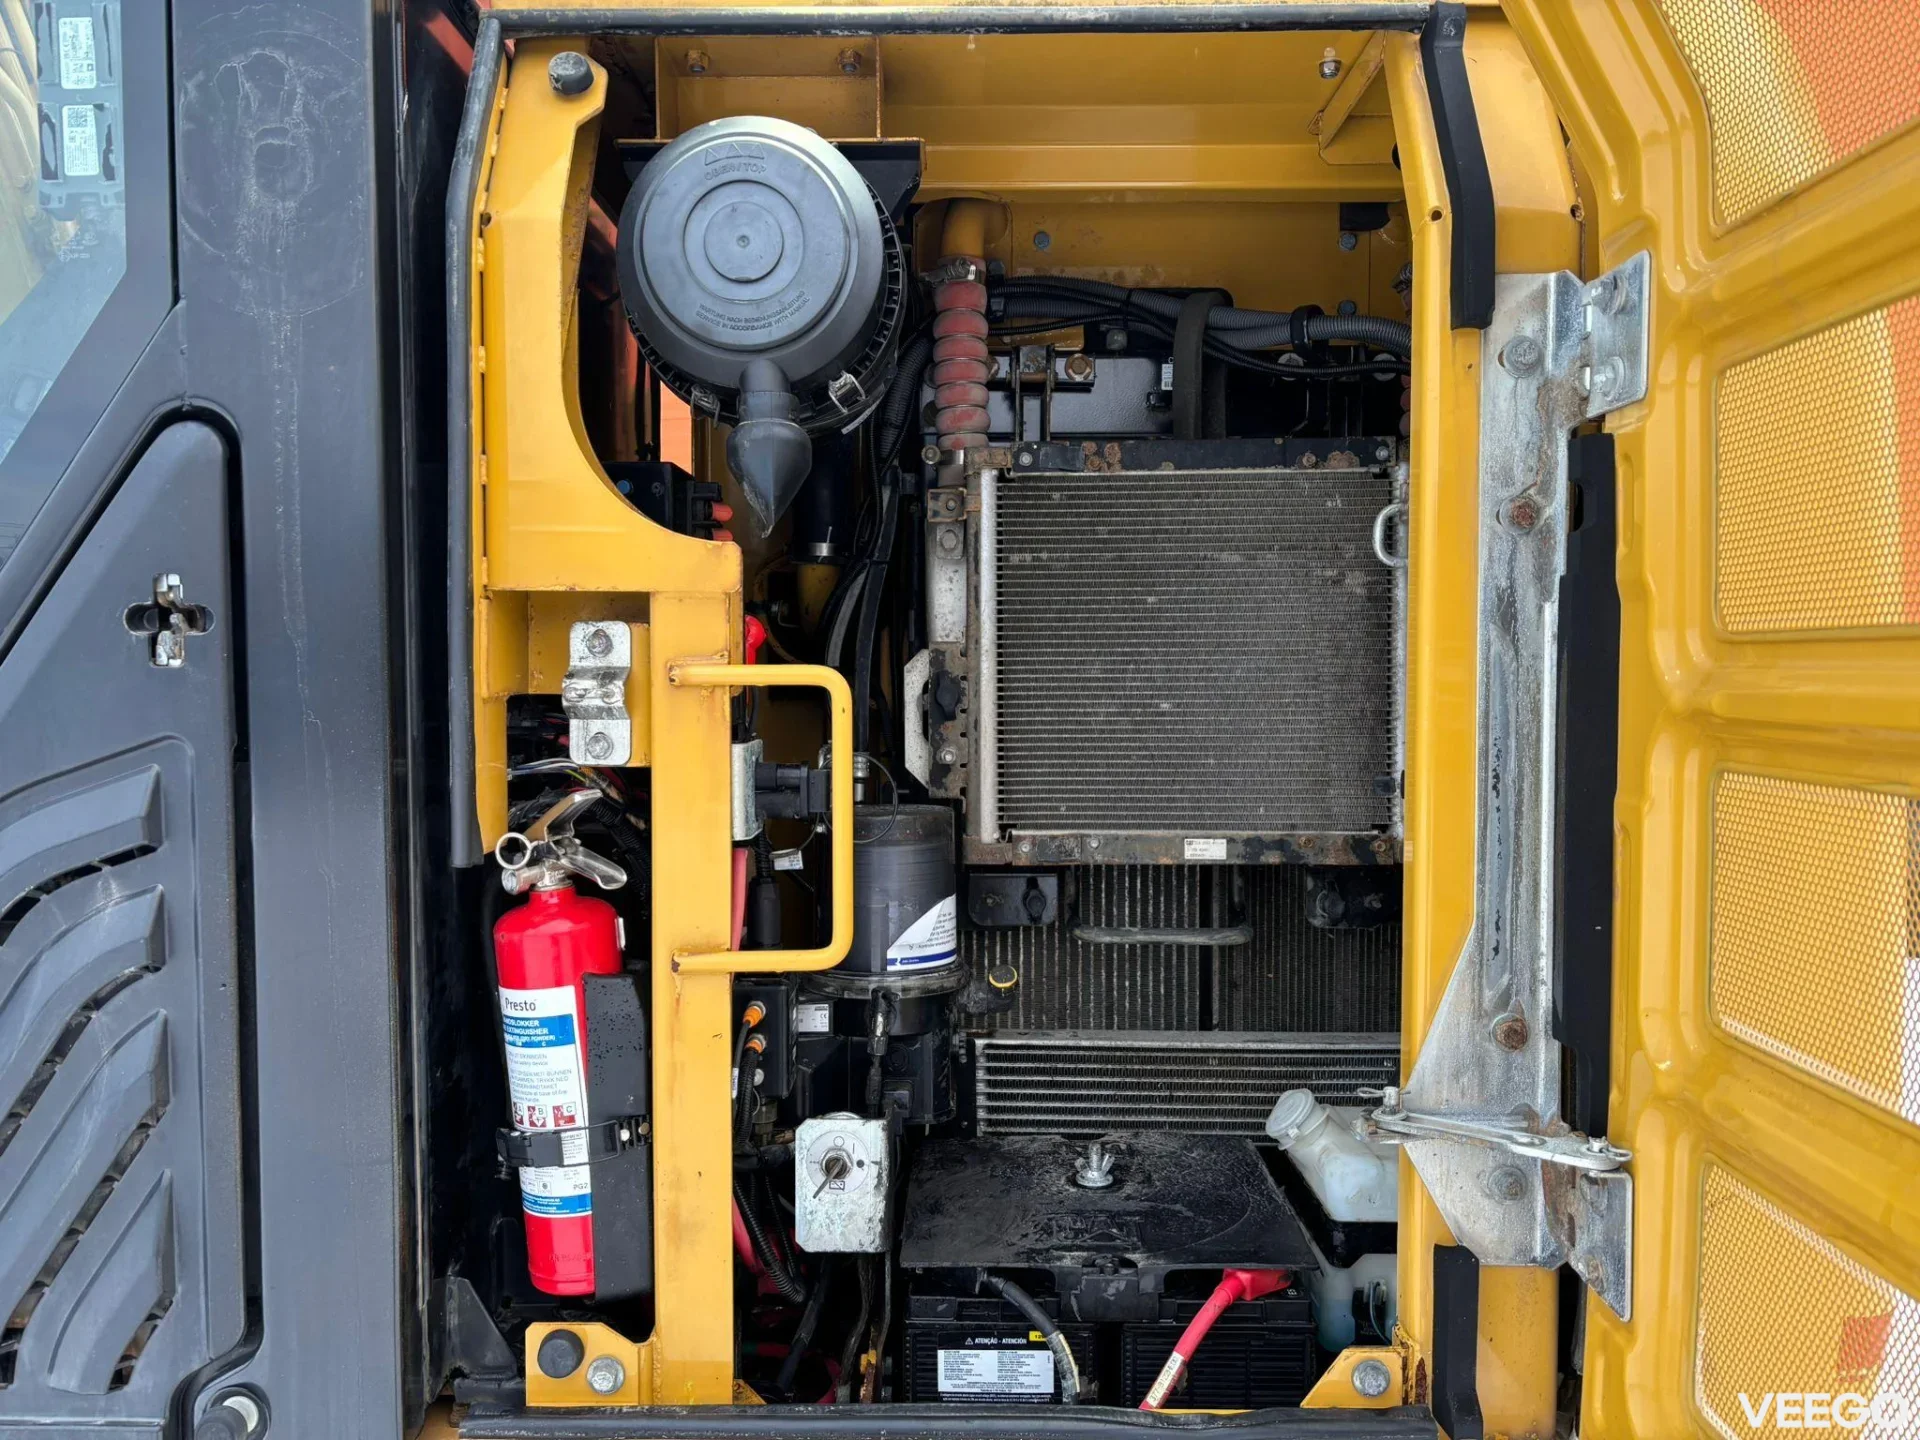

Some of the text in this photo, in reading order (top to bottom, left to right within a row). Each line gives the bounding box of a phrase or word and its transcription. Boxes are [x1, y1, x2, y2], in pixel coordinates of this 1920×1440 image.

[504, 997, 537, 1012] Presto
[974, 1336, 998, 1346] ATENÇÃO
[1001, 1336, 1027, 1345] ATENCIÓN
